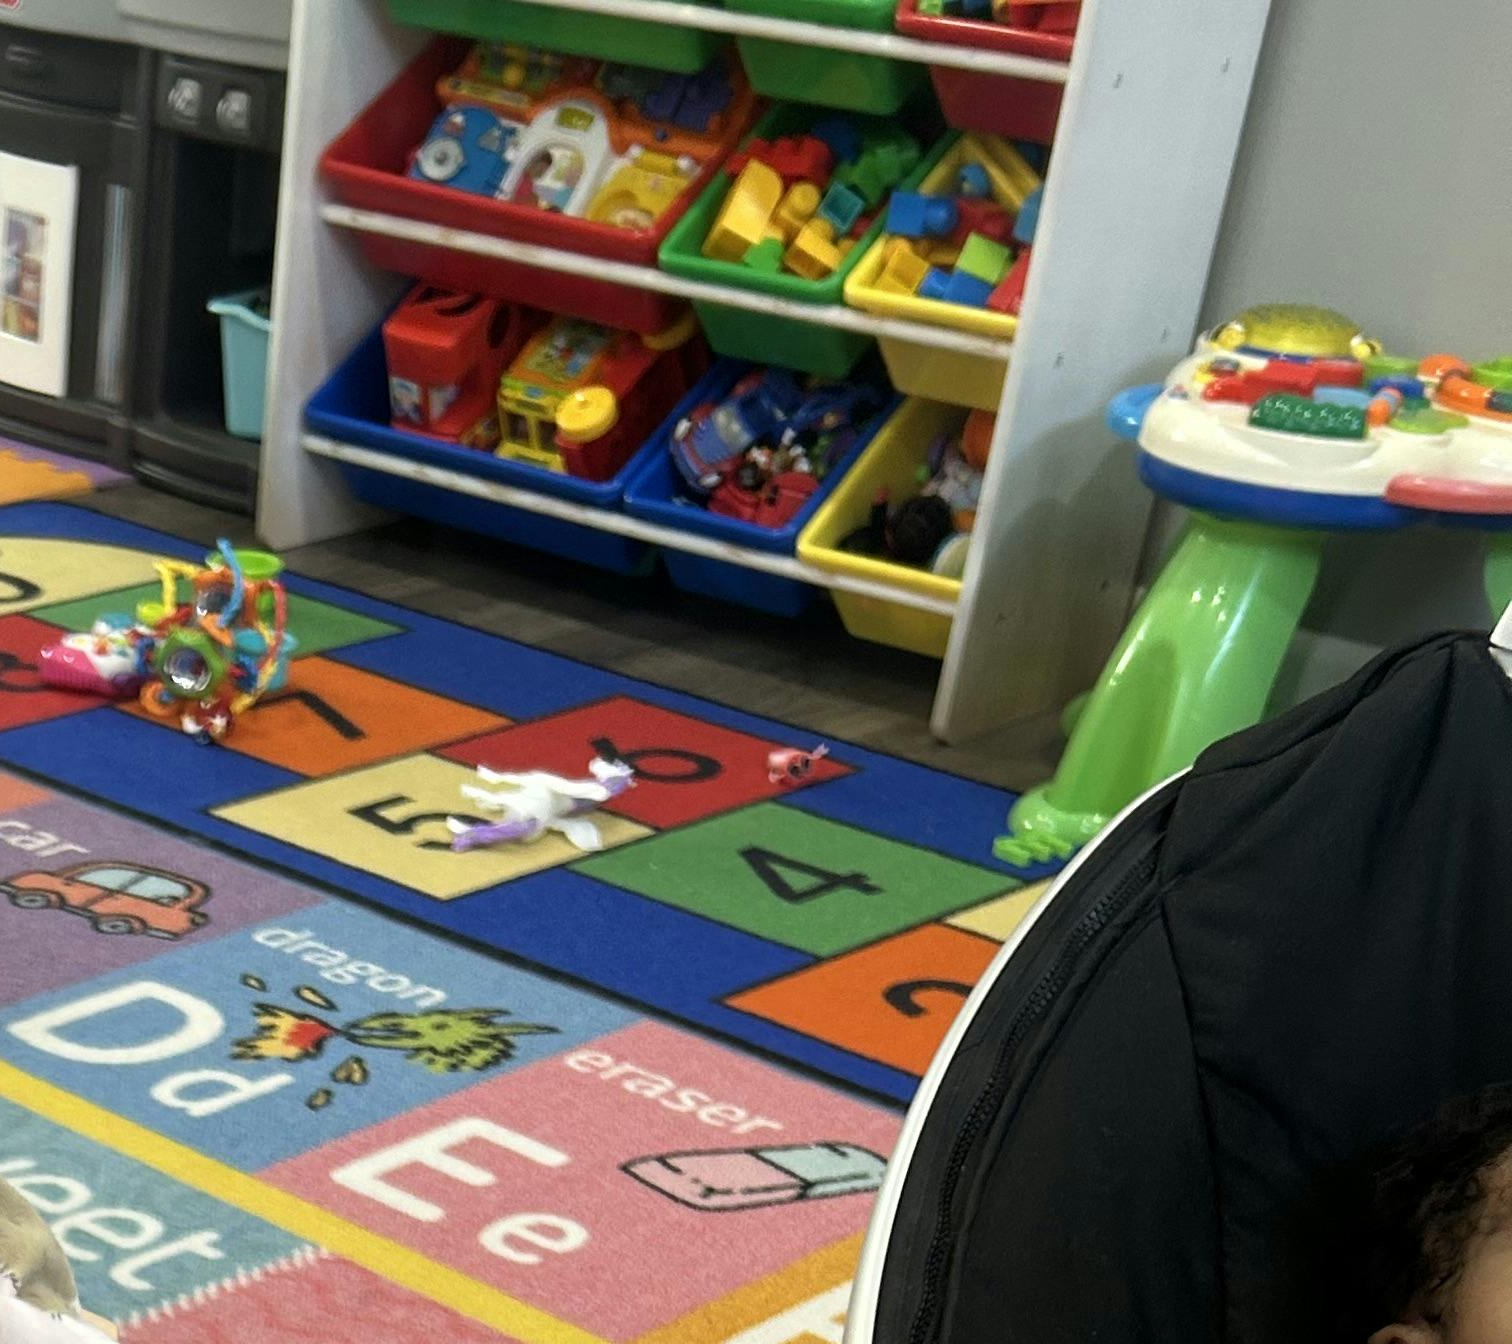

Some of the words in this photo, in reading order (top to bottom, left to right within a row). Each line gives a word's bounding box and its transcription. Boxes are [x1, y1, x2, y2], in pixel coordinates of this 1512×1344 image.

[737, 846, 882, 902] 4
[251, 922, 449, 1009] dragon
[563, 1045, 784, 1139] eraser
